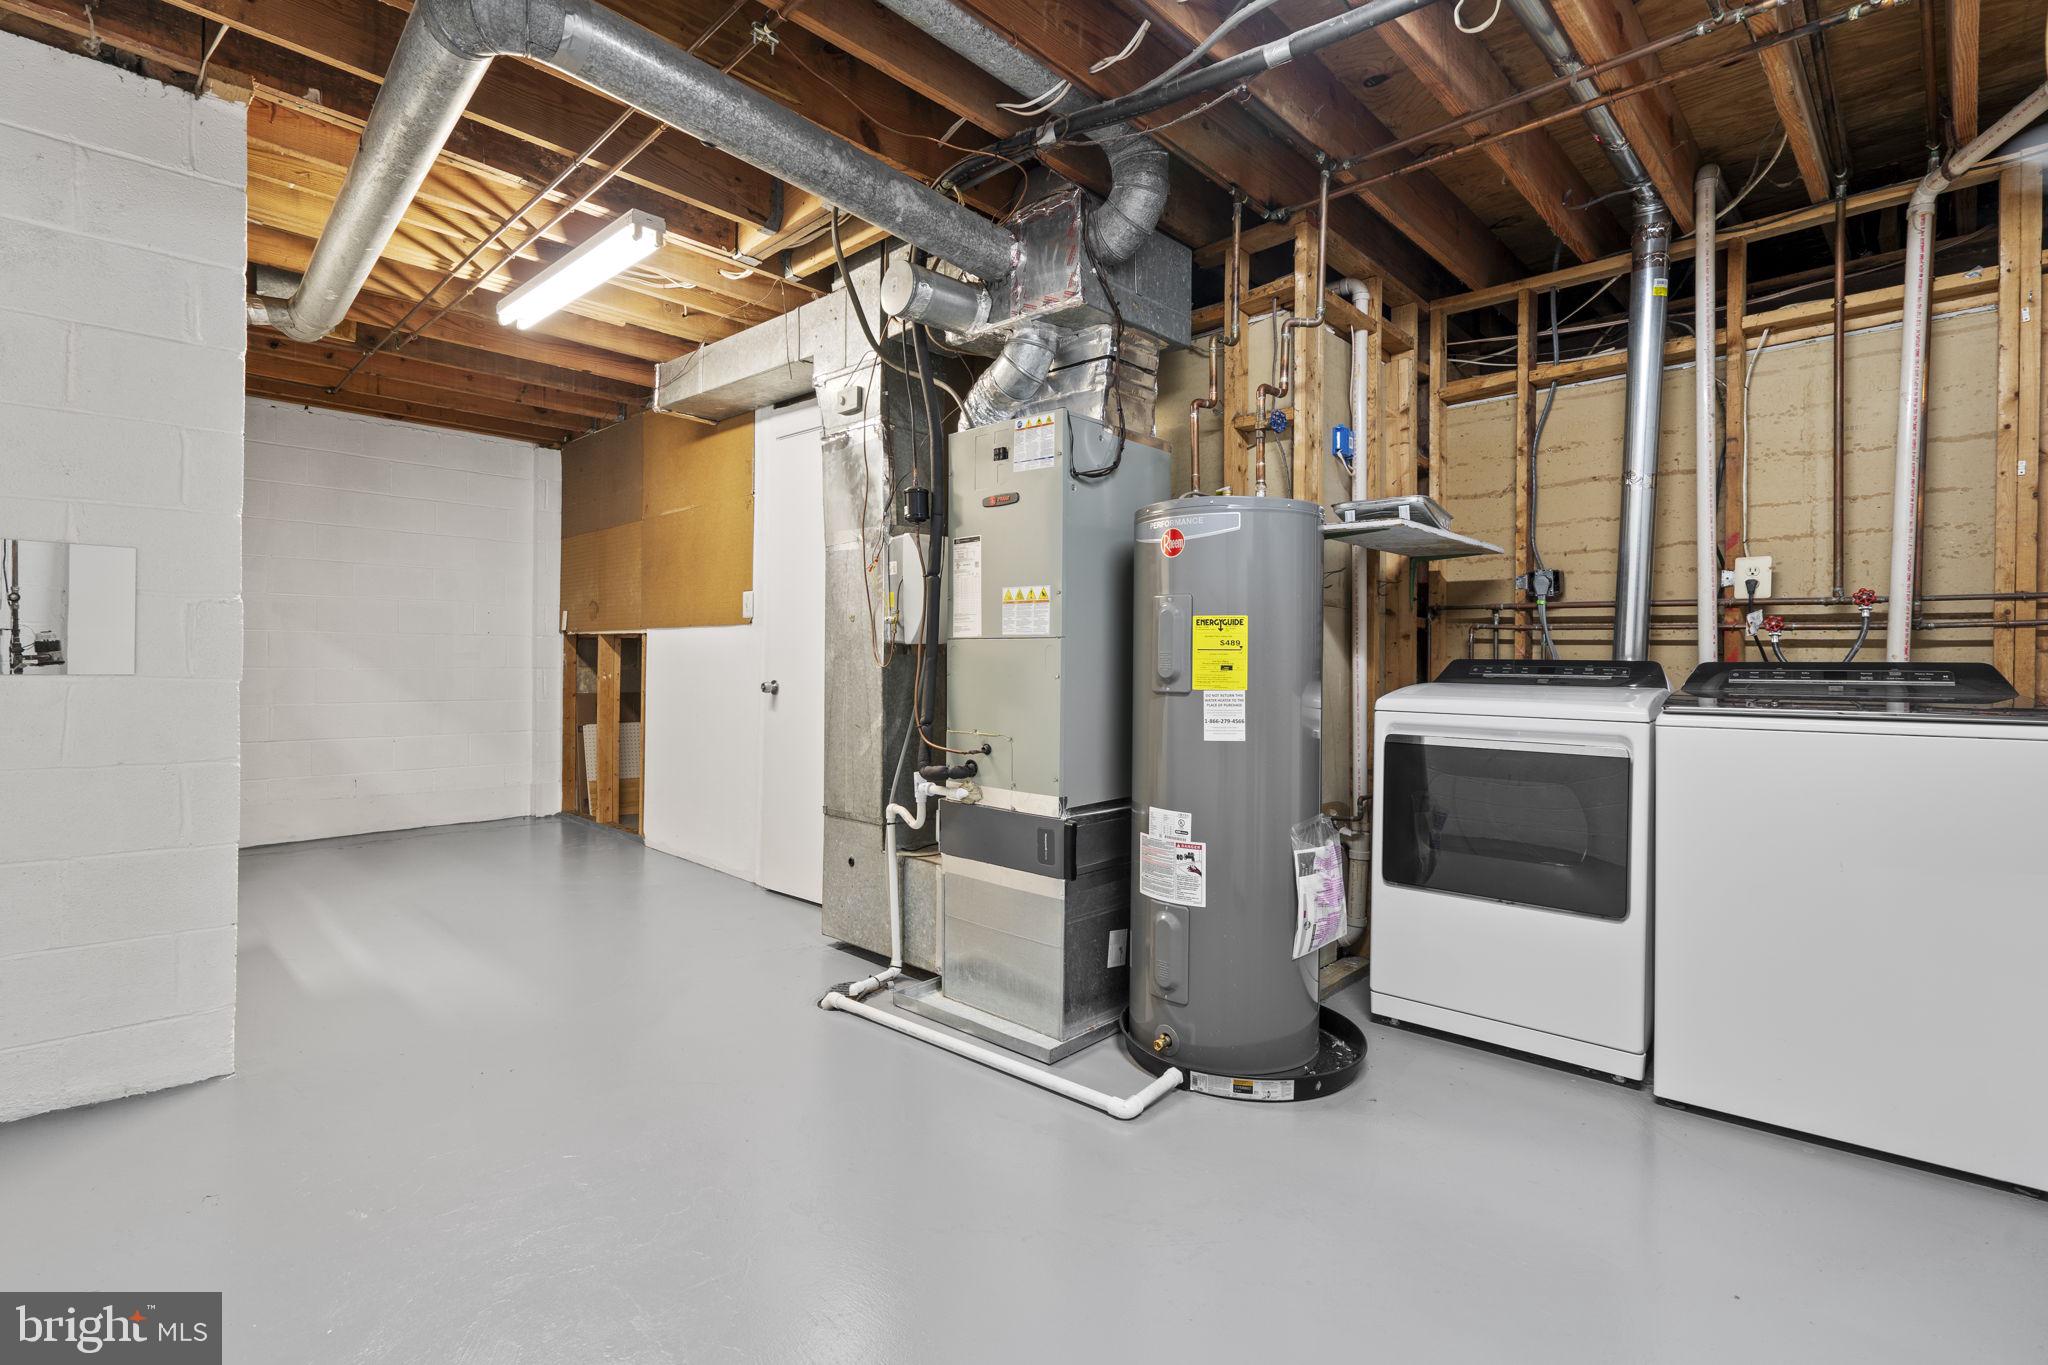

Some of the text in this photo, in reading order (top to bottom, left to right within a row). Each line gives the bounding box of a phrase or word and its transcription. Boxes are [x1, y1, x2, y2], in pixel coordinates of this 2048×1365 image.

[1149, 516, 1204, 529] PERFORMANCE
[1161, 530, 1184, 552] Rheem
[1196, 618, 1244, 627] ENERGYGUIDE
